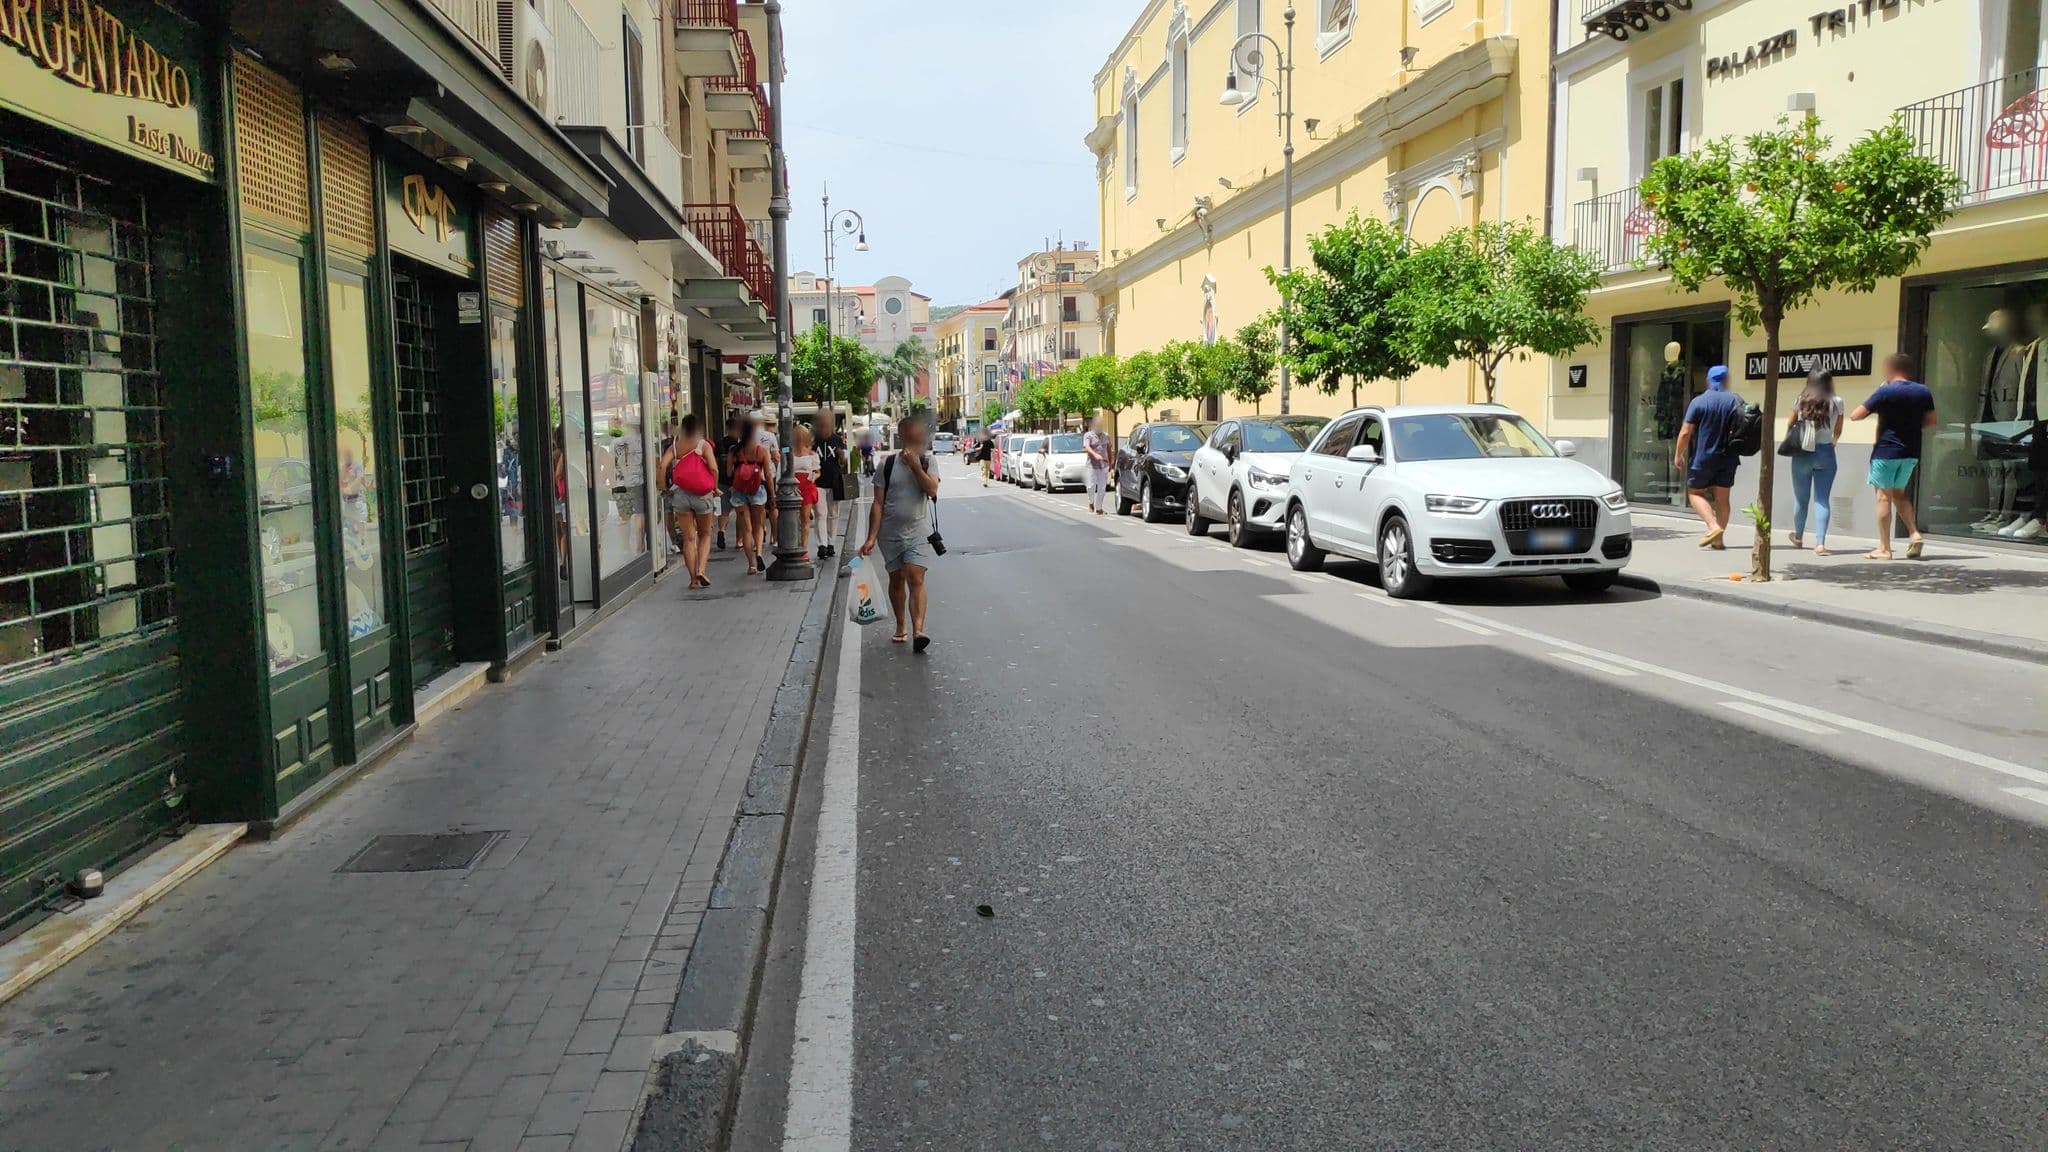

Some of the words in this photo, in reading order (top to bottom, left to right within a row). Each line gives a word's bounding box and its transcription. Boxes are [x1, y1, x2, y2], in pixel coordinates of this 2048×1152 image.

[1706, 29, 1797, 82] PALAZZO
[1808, 0, 1922, 42] TRITO
[172, 134, 215, 172] Nozze
[1748, 355, 1799, 375] EMRIO
